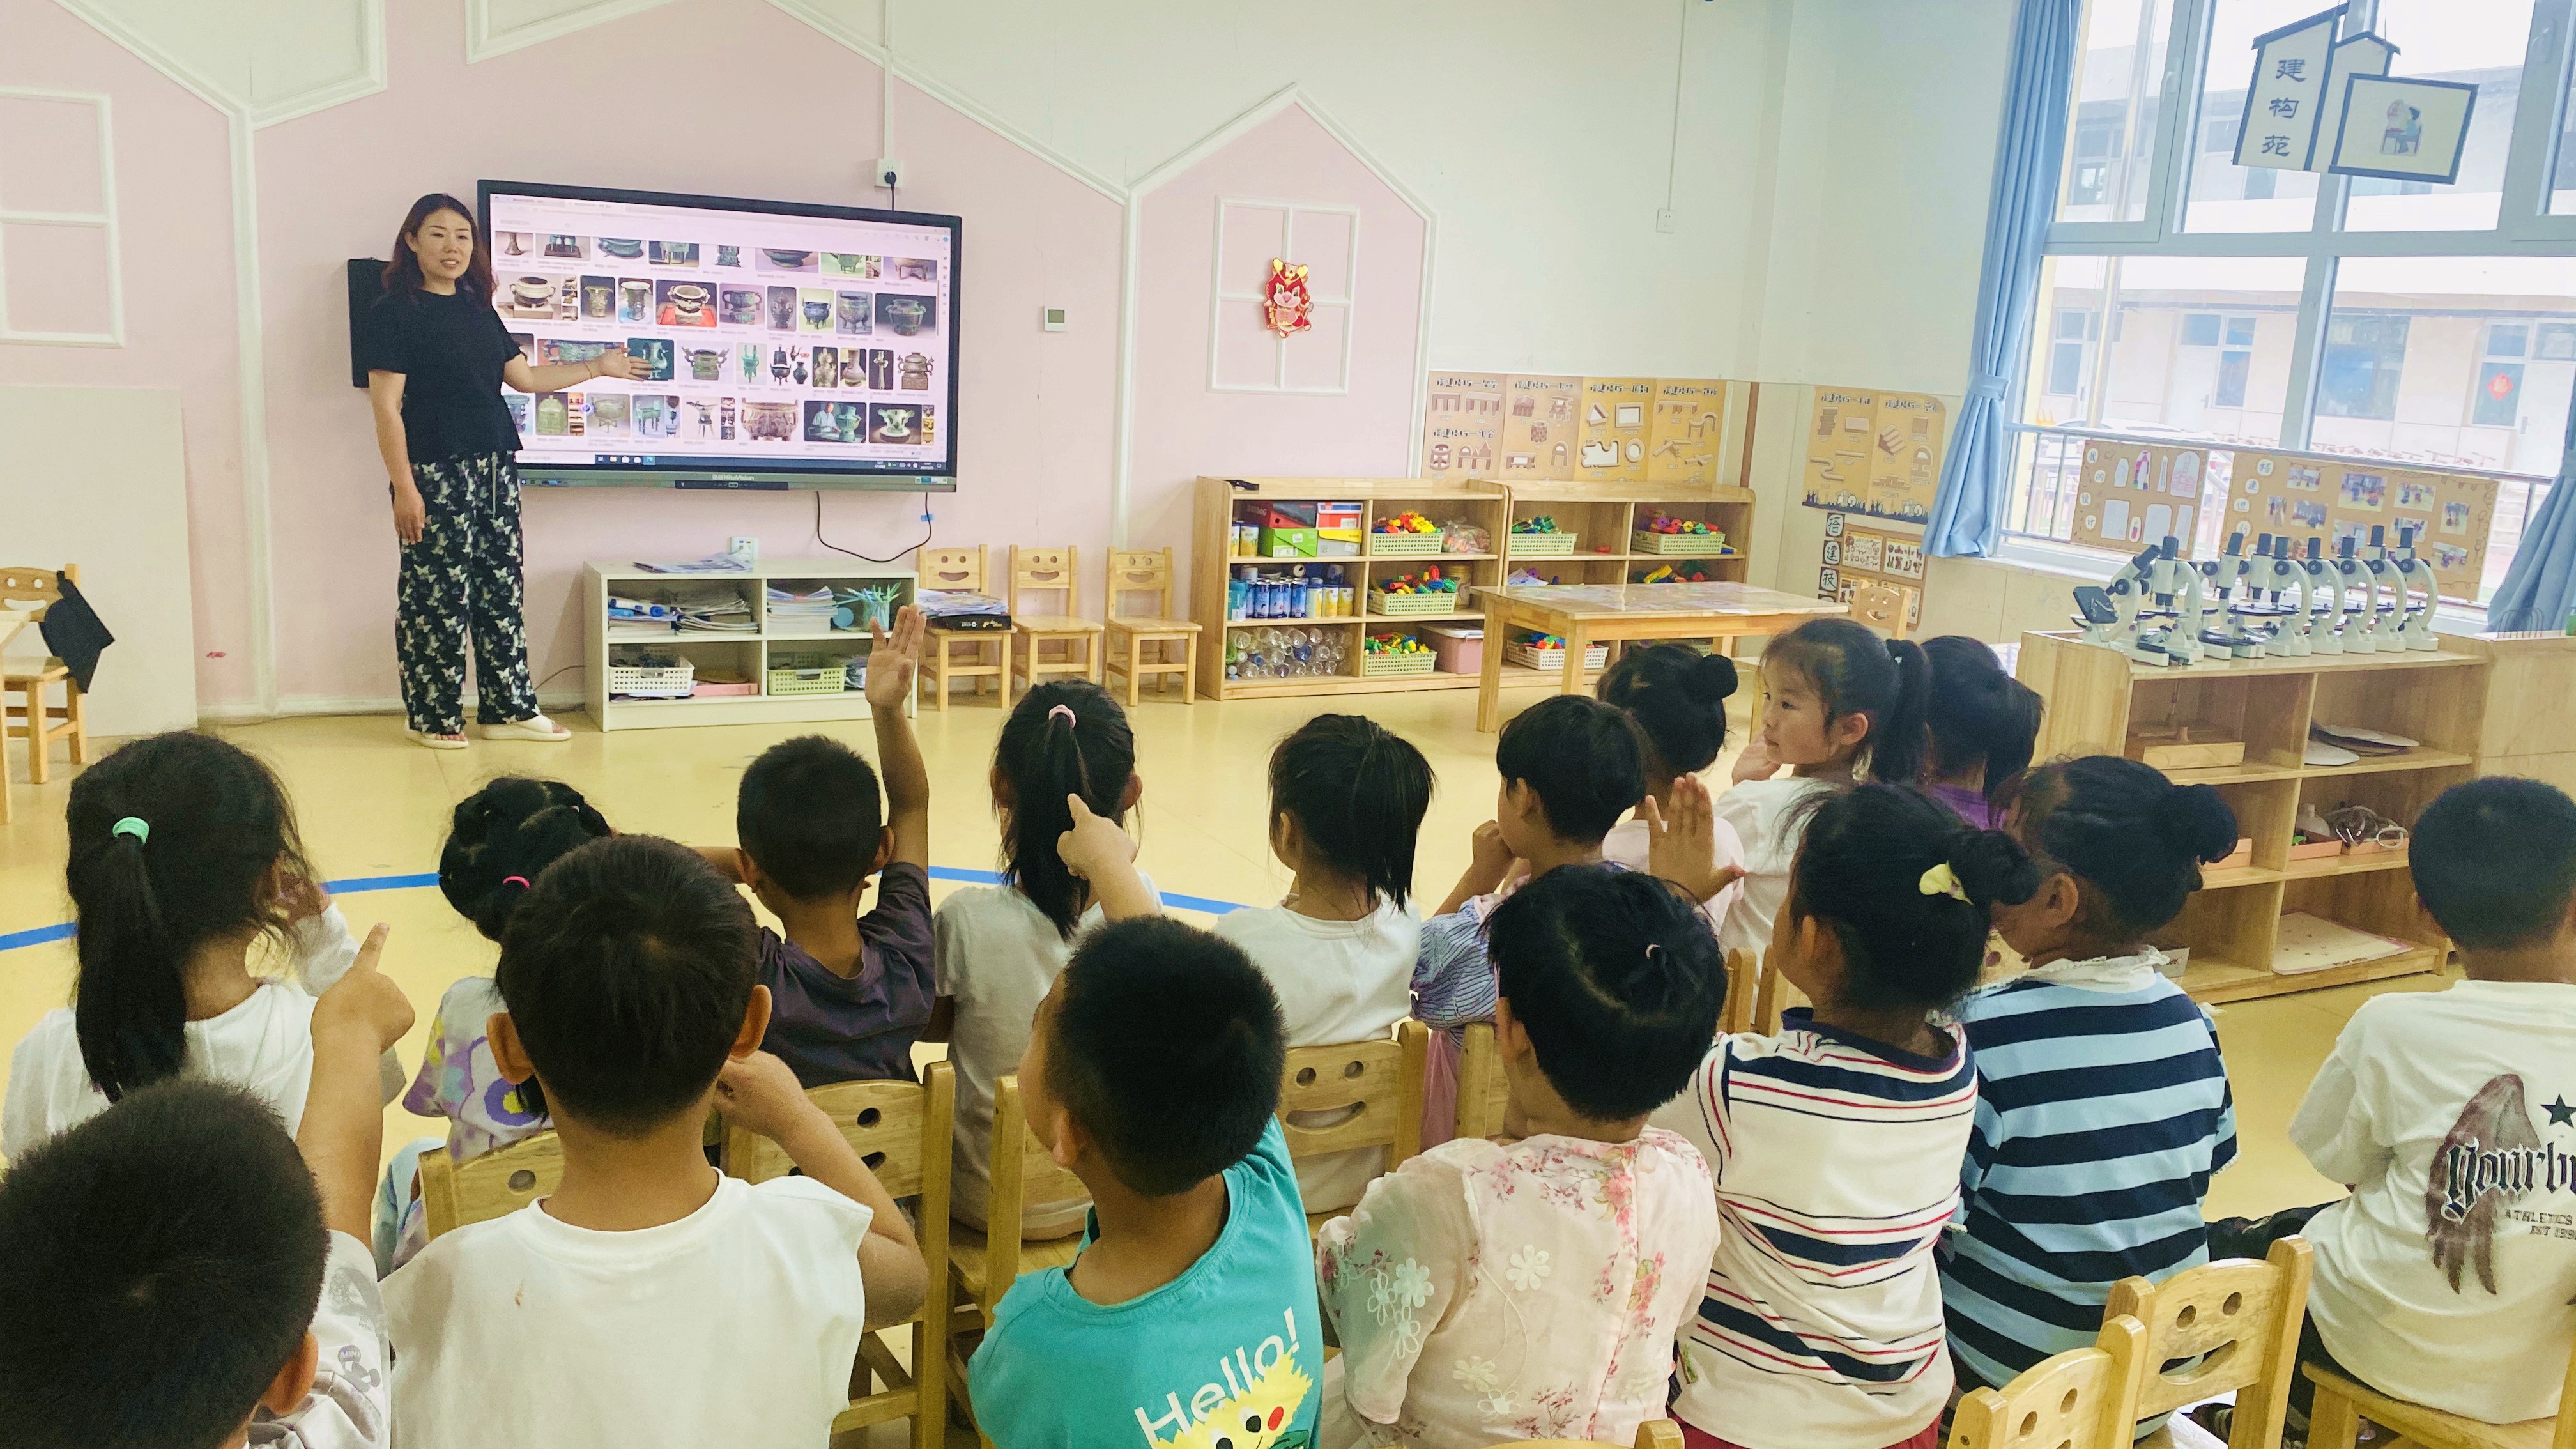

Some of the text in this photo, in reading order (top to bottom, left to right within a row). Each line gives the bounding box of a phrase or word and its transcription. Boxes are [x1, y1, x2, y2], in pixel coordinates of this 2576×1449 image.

[2262, 58, 2307, 157] 建构苑
[2505, 1209, 2573, 1225] ATHLETICS
[2530, 1225, 2551, 1236] EST
[1134, 1306, 1300, 1449] Hello!
